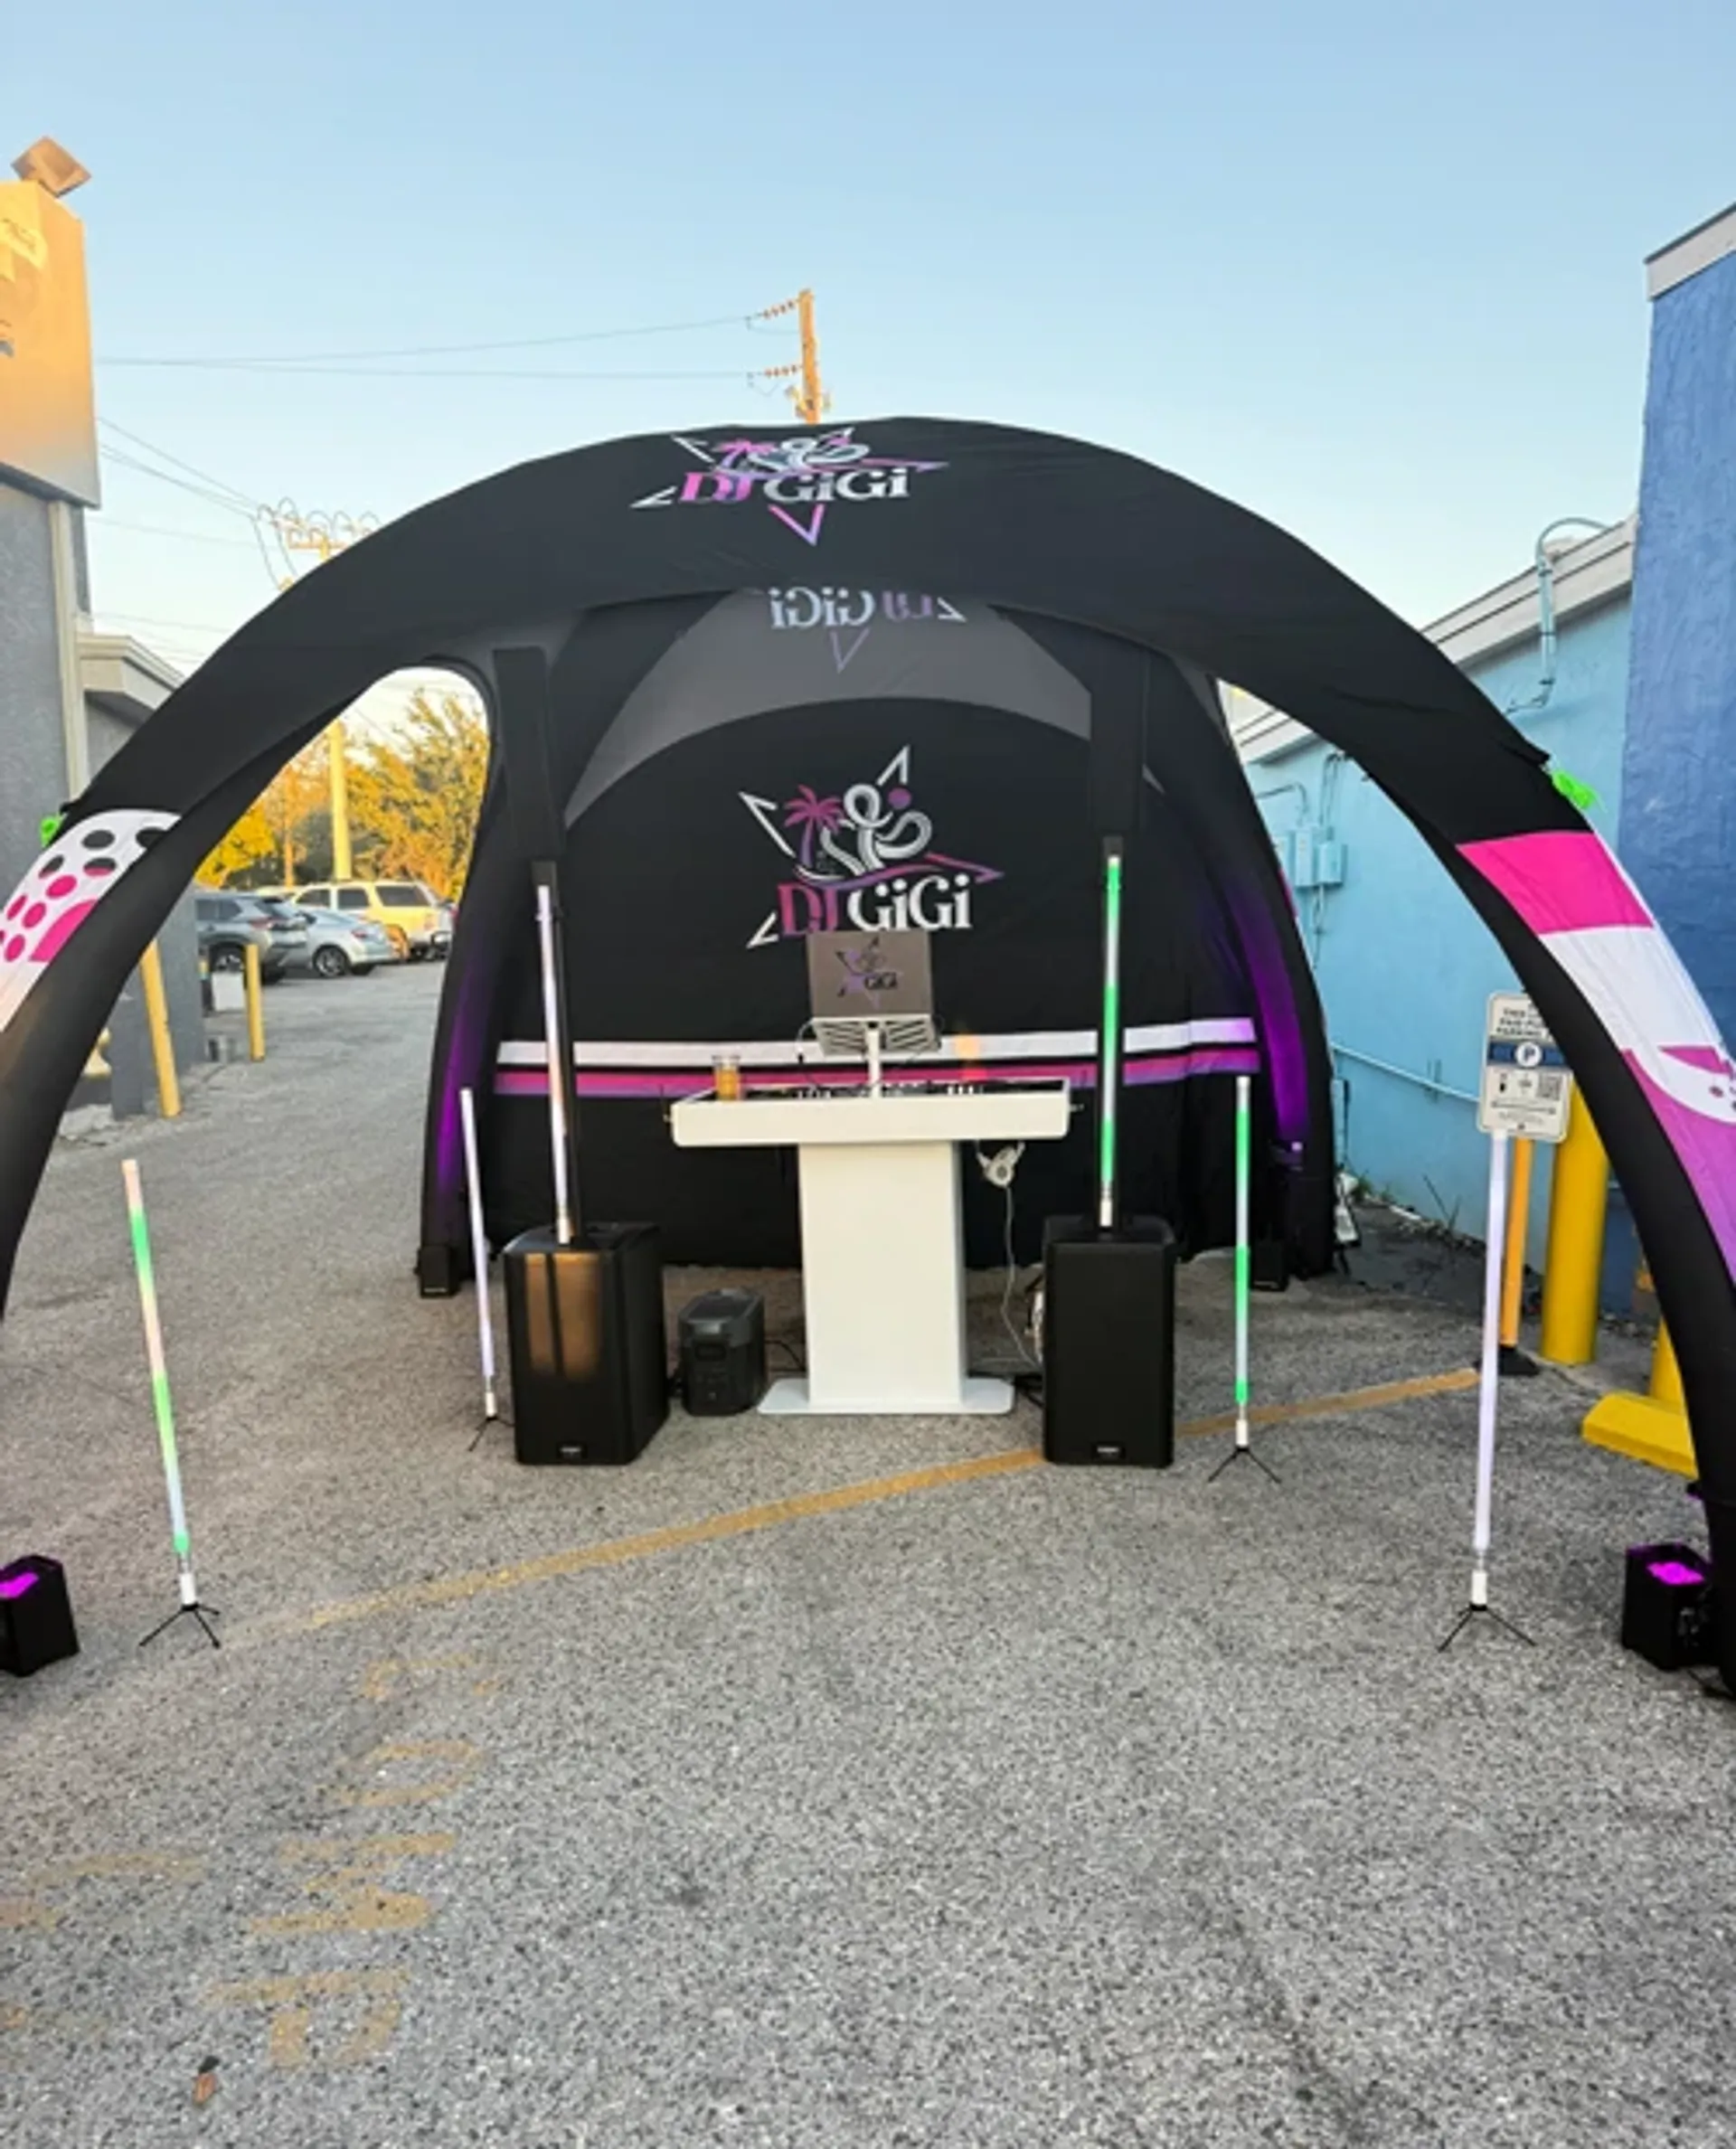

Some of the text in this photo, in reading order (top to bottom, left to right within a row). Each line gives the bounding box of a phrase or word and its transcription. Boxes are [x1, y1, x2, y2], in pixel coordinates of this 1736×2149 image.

[679, 467, 910, 504] DJ GiGi
[777, 874, 973, 939] DJ GiGi
